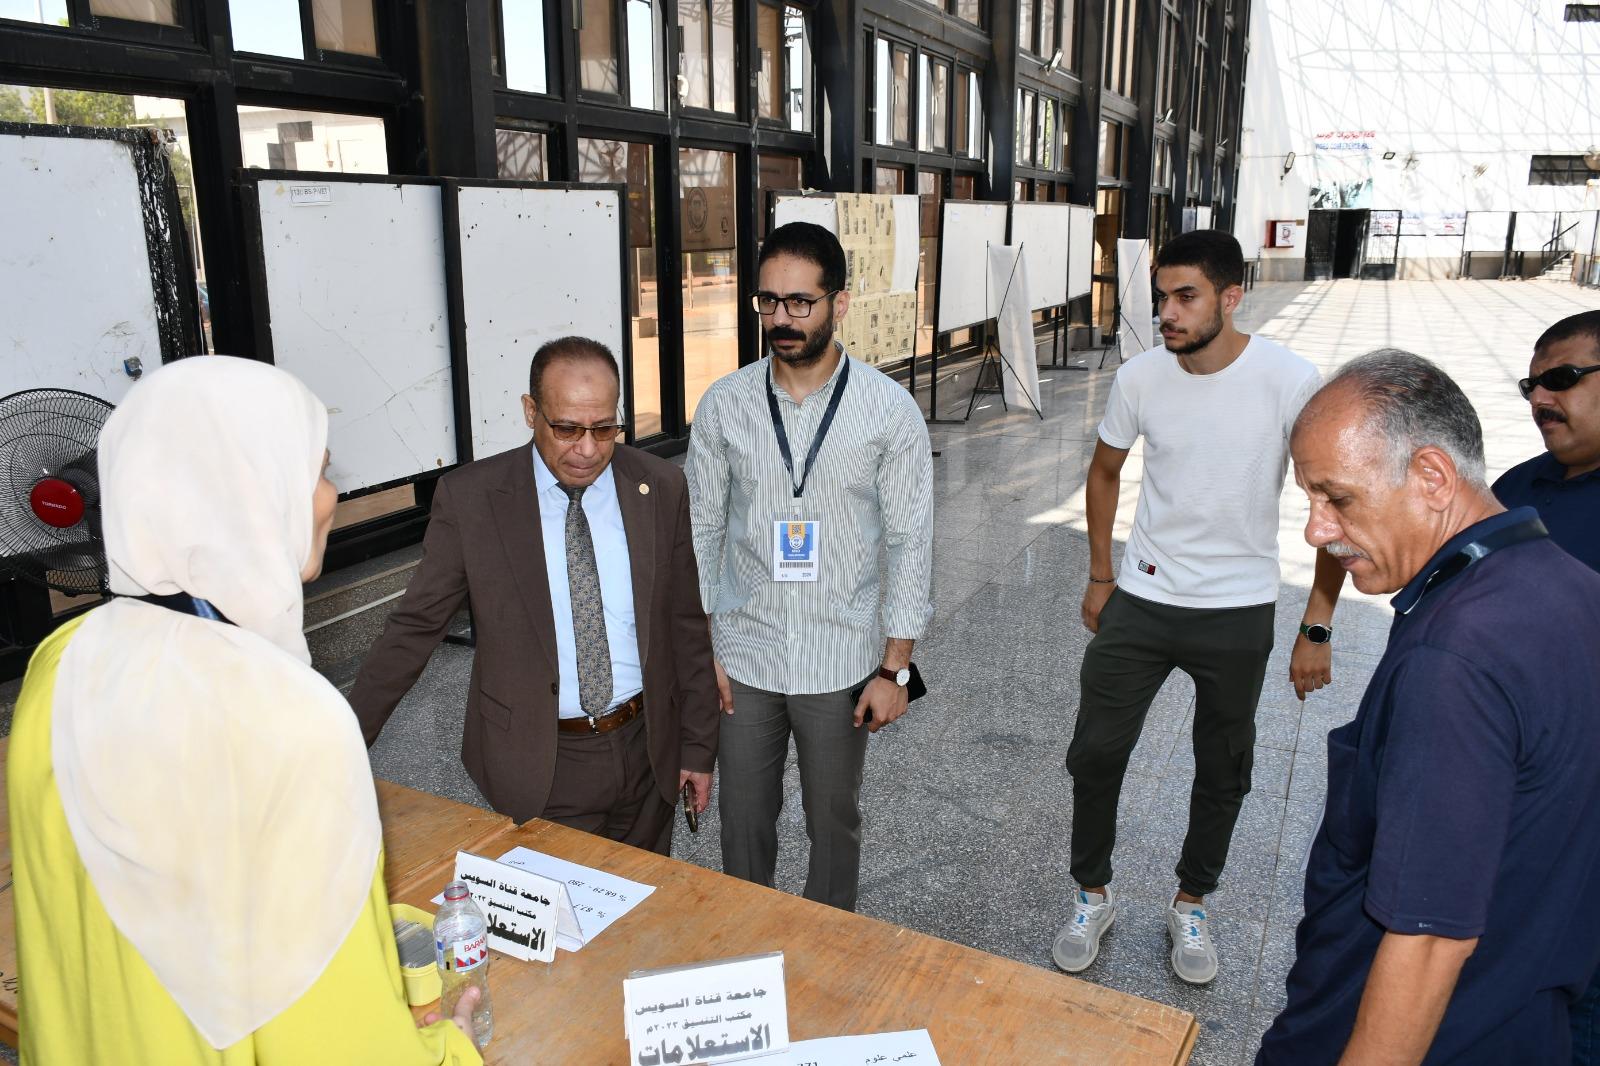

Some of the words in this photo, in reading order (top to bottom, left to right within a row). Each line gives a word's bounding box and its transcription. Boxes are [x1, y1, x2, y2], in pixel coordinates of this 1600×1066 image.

[460, 873, 496, 888] السويس
[499, 882, 518, 896] قناة
[470, 892, 486, 902] ٢٠٢٣
[521, 889, 550, 906] جامعة
[488, 898, 515, 912] التنسيق
[517, 909, 537, 919] مكتب
[487, 913, 546, 952] الاستعلا
[695, 993, 722, 1006] قناة
[726, 987, 767, 1000] جامعة
[635, 997, 690, 1016] السويس
[682, 1015, 722, 1030] التنسيق
[725, 1010, 752, 1023] مكتب
[638, 1023, 771, 1066] الاستعلامات
